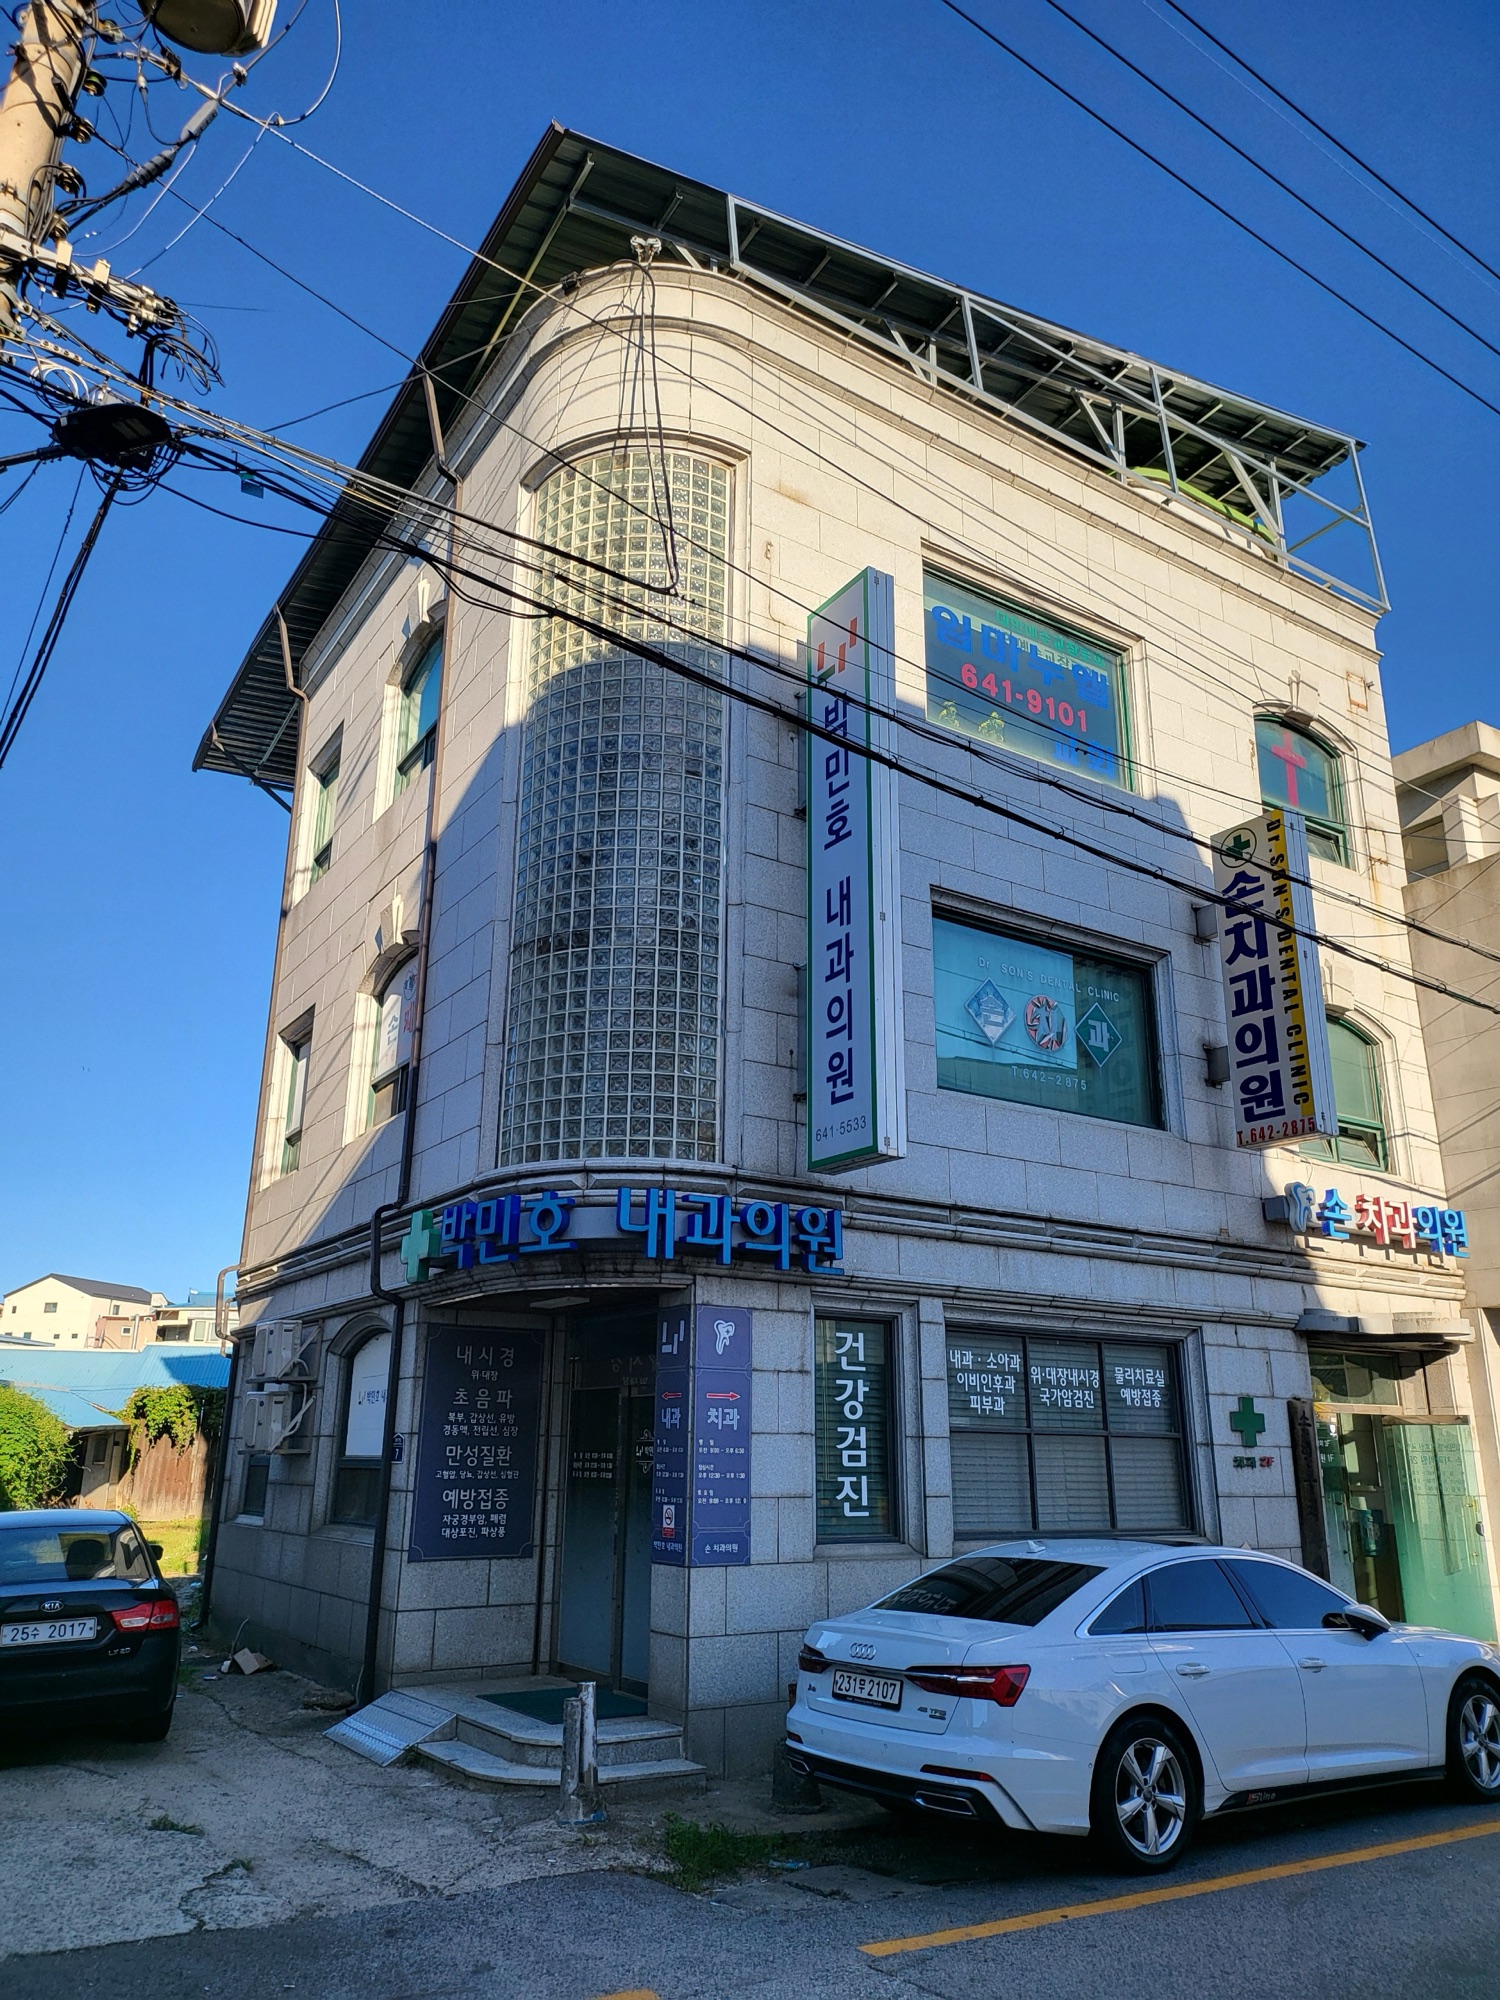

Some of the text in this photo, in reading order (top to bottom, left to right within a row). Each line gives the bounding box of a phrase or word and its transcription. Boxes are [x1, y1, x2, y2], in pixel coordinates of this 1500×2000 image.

[961, 663, 1087, 733] 641-9101
[1054, 728, 1116, 780] 교회
[823, 690, 856, 1106] 박민호 내과의원
[1276, 927, 1299, 1015] DENTAL
[1040, 974, 1081, 993] DENTAL
[1087, 986, 1120, 1003] CLINIC
[1221, 869, 1287, 1124] 손치과의원
[1286, 1023, 1310, 1106] CLINIC
[1011, 1065, 1088, 1091] T.642-2875
[1238, 1116, 1317, 1147] T.642-2875
[440, 1186, 846, 1276] 박민호 내과의원
[1317, 1188, 1471, 1260] 손 치과의원
[456, 1345, 516, 1368] 내시경
[950, 1349, 1021, 1373] 내과 소아과
[957, 1372, 1017, 1395] 이비인후과
[1114, 1366, 1166, 1387] 물리치료실
[452, 1388, 514, 1410] 초음파
[969, 1395, 1006, 1416] 피부과
[1039, 1388, 1095, 1410] 국가암검진
[1120, 1388, 1163, 1409] 예방접종
[499, 1412, 516, 1425] 유방
[661, 1407, 681, 1430] 내과
[707, 1407, 740, 1431] 치과
[835, 1332, 870, 1518] 건강검진
[502, 1425, 519, 1437] 심장
[445, 1445, 513, 1467] 만성질환
[442, 1488, 510, 1510] 예방접종
[481, 1526, 506, 1538] 파상풍
[704, 1543, 739, 1554] 손 치과의원
[44, 1602, 60, 1611] KIA
[10, 1622, 87, 1643] 25수 2017
[868, 1679, 897, 1701] 2107
